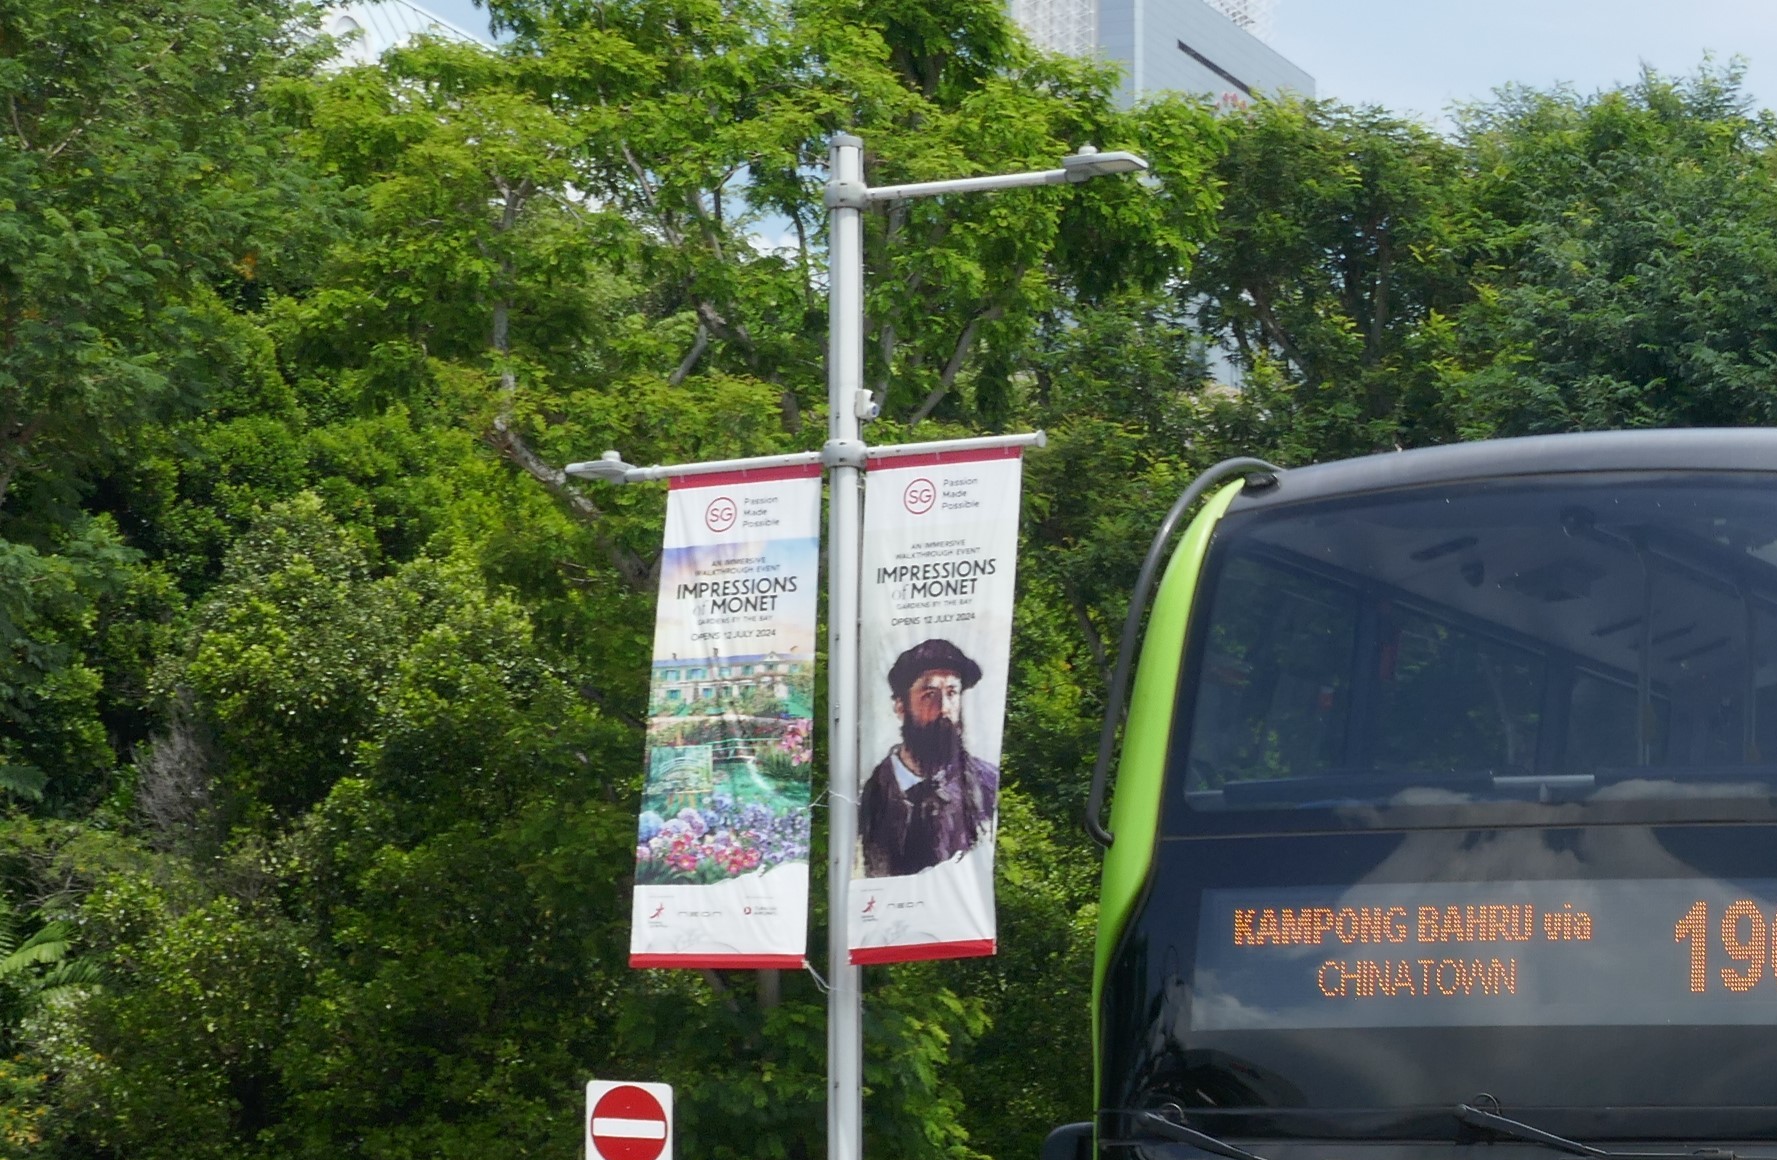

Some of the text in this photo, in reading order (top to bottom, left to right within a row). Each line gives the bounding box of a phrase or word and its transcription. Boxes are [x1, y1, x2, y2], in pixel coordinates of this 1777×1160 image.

[943, 478, 978, 487] Passion
[744, 496, 779, 504] Passion
[908, 489, 932, 504] SG
[942, 490, 967, 498] Made
[942, 501, 980, 509] Possible
[709, 507, 733, 523] SG
[742, 519, 780, 528] Possible
[956, 547, 981, 555] EVENT
[876, 558, 997, 584] IMPRESSIONS
[677, 575, 798, 600] IMPRESSIONS
[891, 578, 978, 600] of MONET
[711, 595, 778, 615] MONET
[891, 612, 976, 626] OPENS 12 JULY 2024
[690, 628, 777, 641] OPENS 12 JULY 2024
[1234, 902, 1592, 947] KAMPONG BAHRU via
[1317, 957, 1517, 997] CHINATOWN
